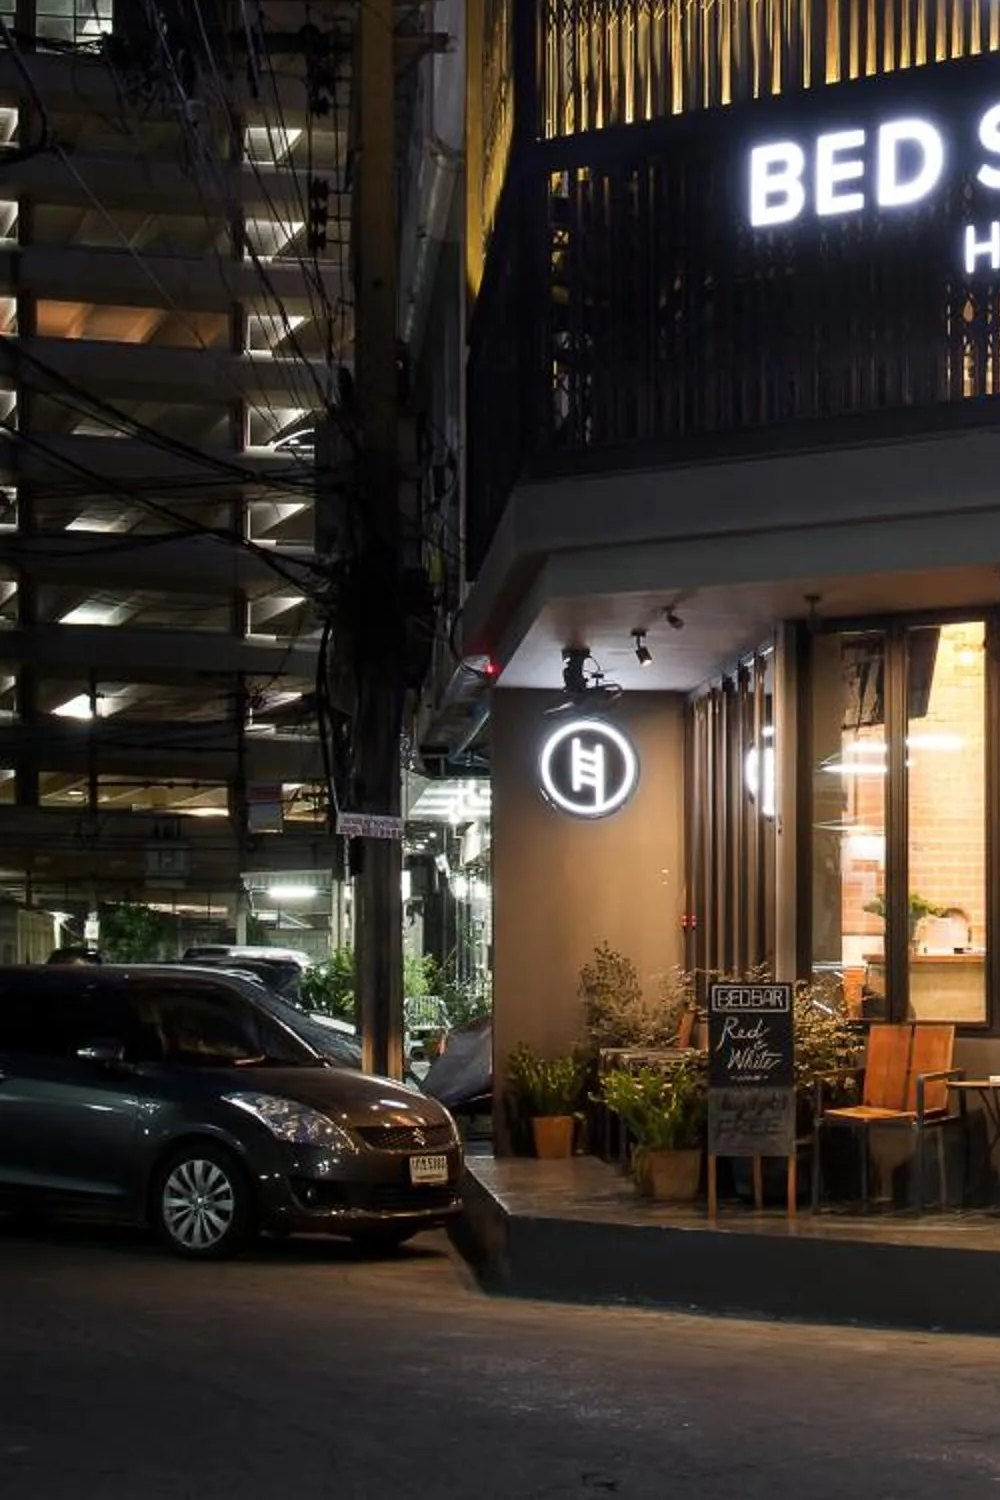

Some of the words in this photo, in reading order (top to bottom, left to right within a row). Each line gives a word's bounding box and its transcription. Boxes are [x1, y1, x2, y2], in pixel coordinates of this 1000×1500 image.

[748, 117, 945, 228] BED
[715, 1017, 770, 1052] Red
[727, 1047, 783, 1069] White
